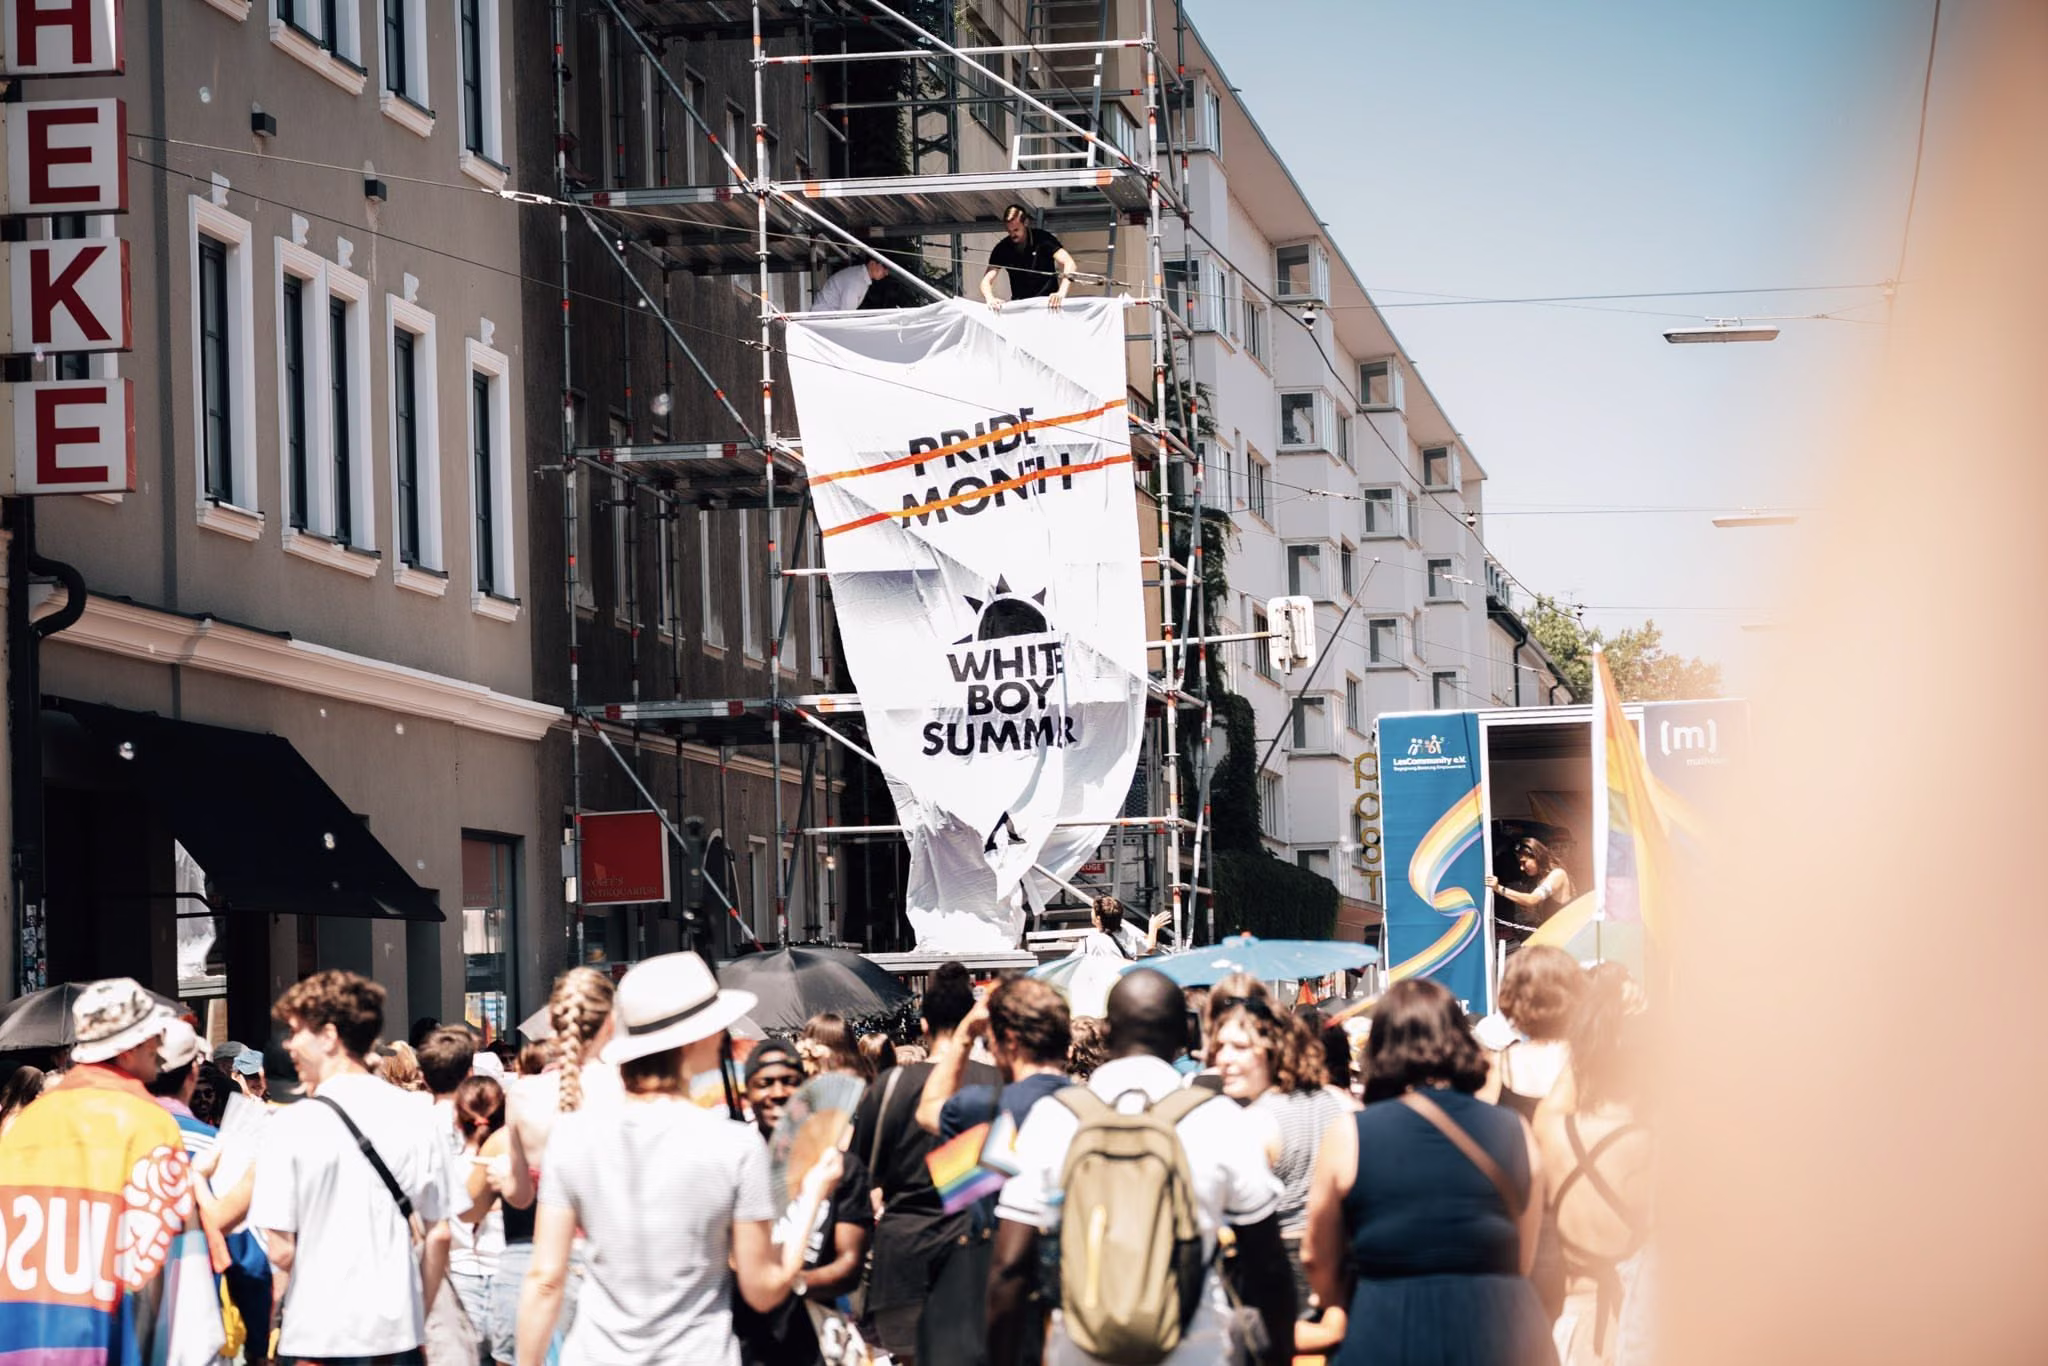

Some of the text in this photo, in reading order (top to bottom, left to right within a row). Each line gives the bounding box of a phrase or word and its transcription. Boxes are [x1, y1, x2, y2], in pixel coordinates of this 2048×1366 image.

[909, 407, 1036, 477] PRIDE
[946, 642, 1064, 682] WHITE
[967, 678, 1055, 716] BOY
[922, 716, 1078, 756] SUMMR
